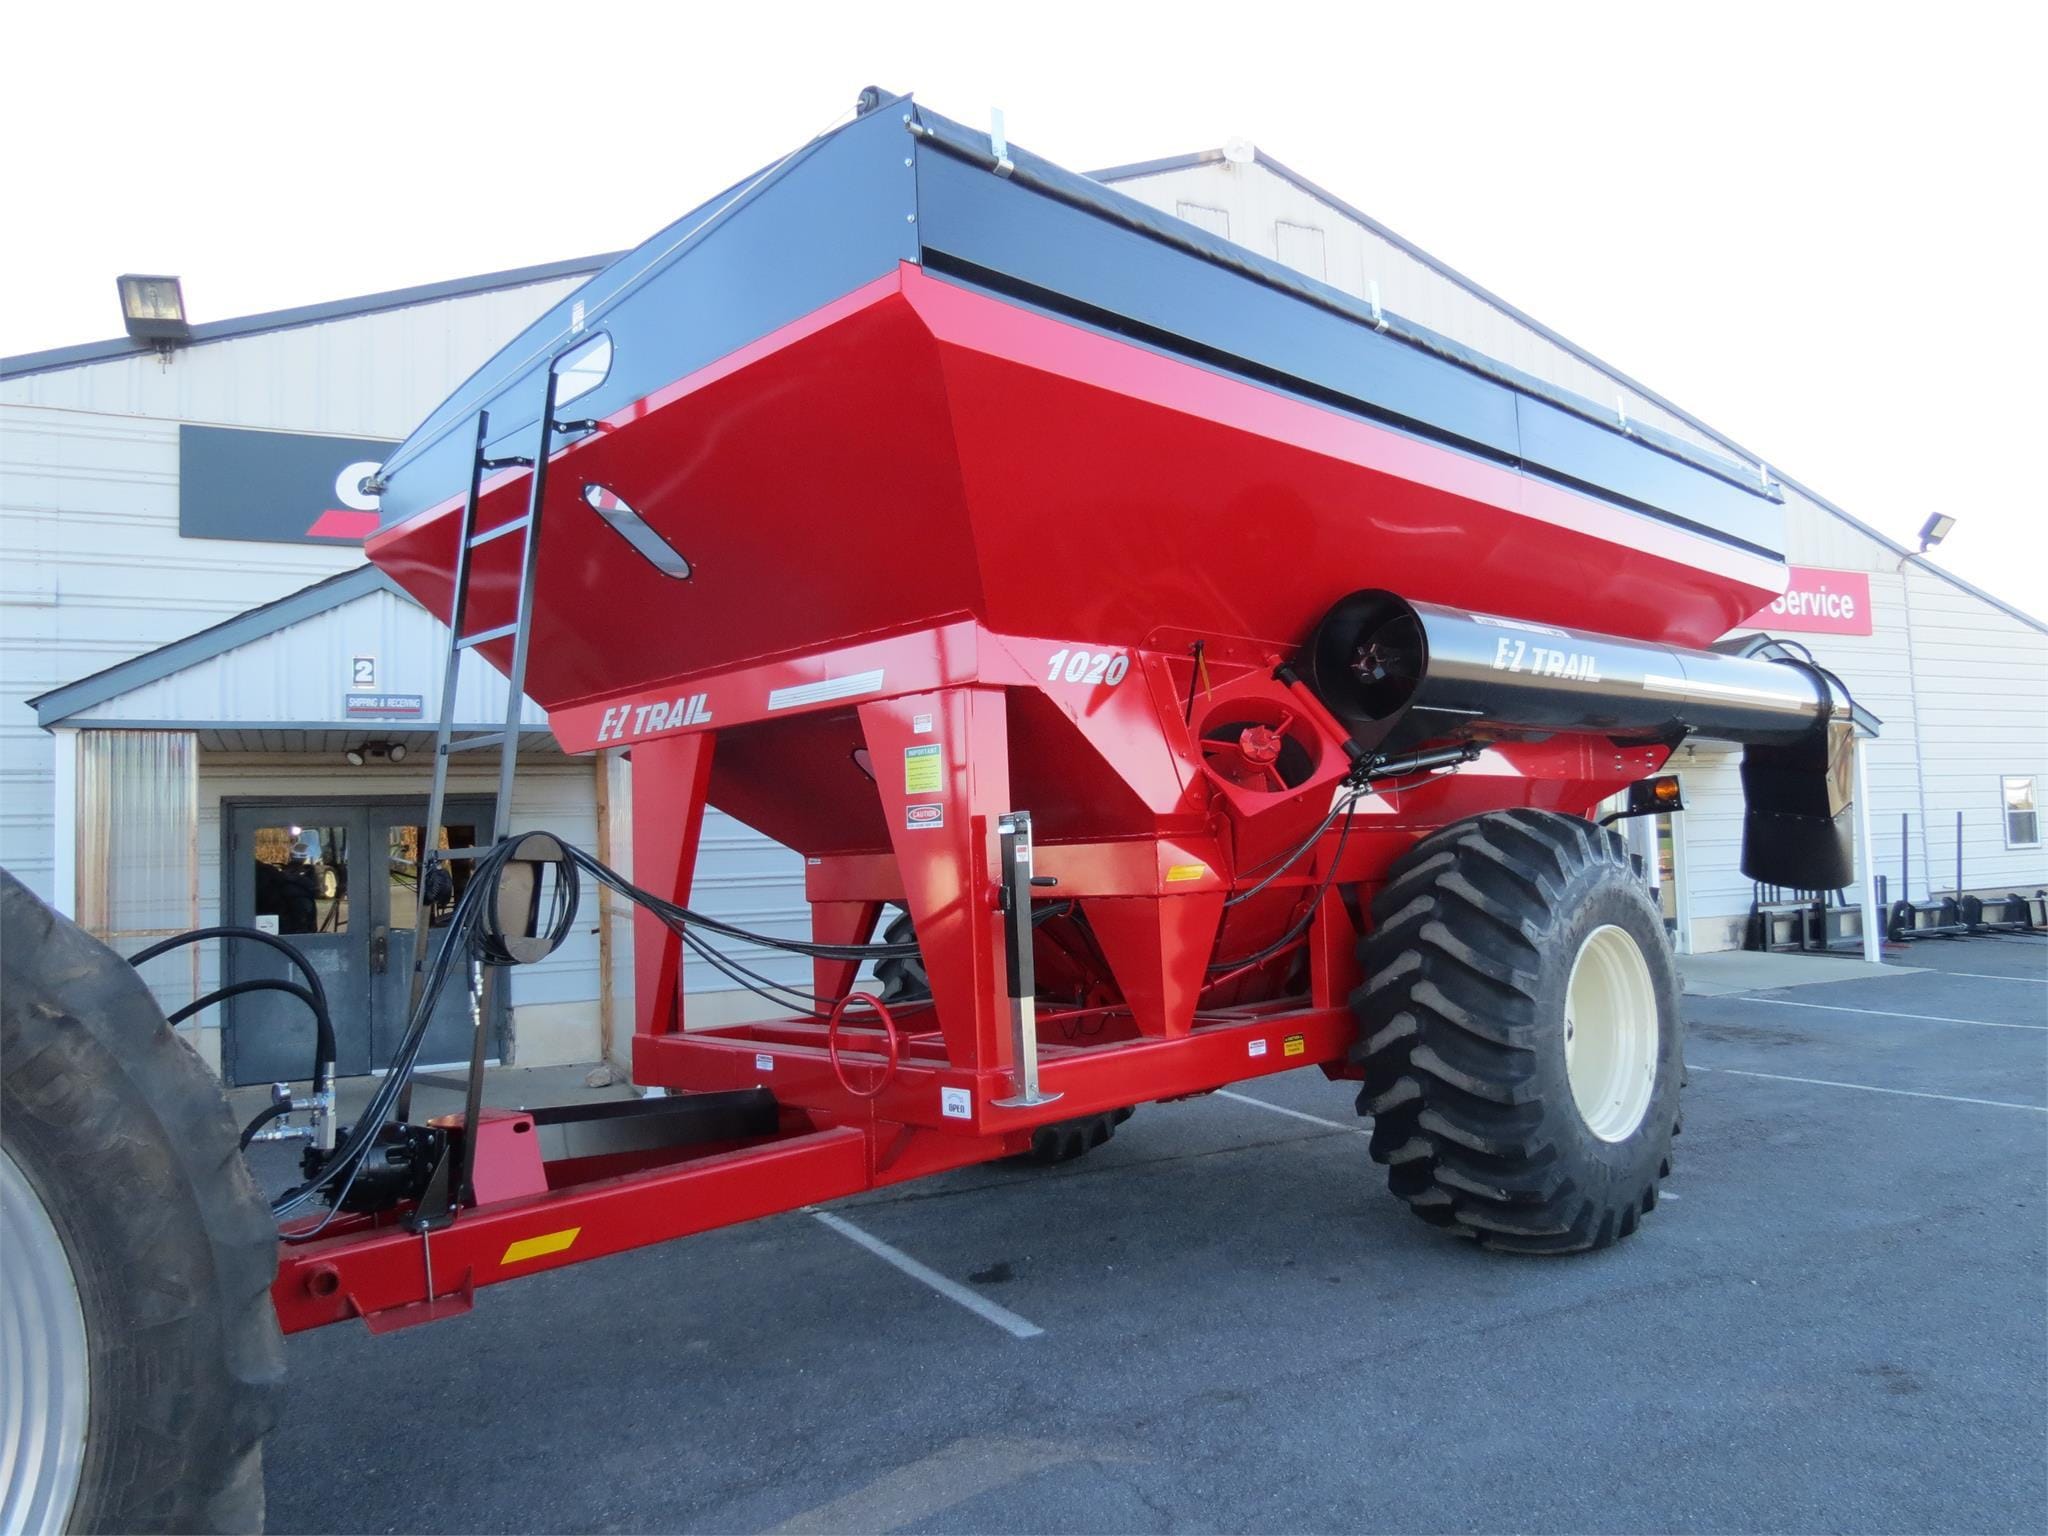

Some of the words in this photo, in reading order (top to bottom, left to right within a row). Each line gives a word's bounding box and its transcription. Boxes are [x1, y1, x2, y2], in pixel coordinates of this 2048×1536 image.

[355, 660, 373, 682] 2
[1047, 649, 1129, 686] 1020
[1492, 637, 1526, 673] E-Z
[1531, 647, 1602, 683] TRAIL
[597, 704, 632, 742] E-Z
[633, 693, 713, 735] TRAIL
